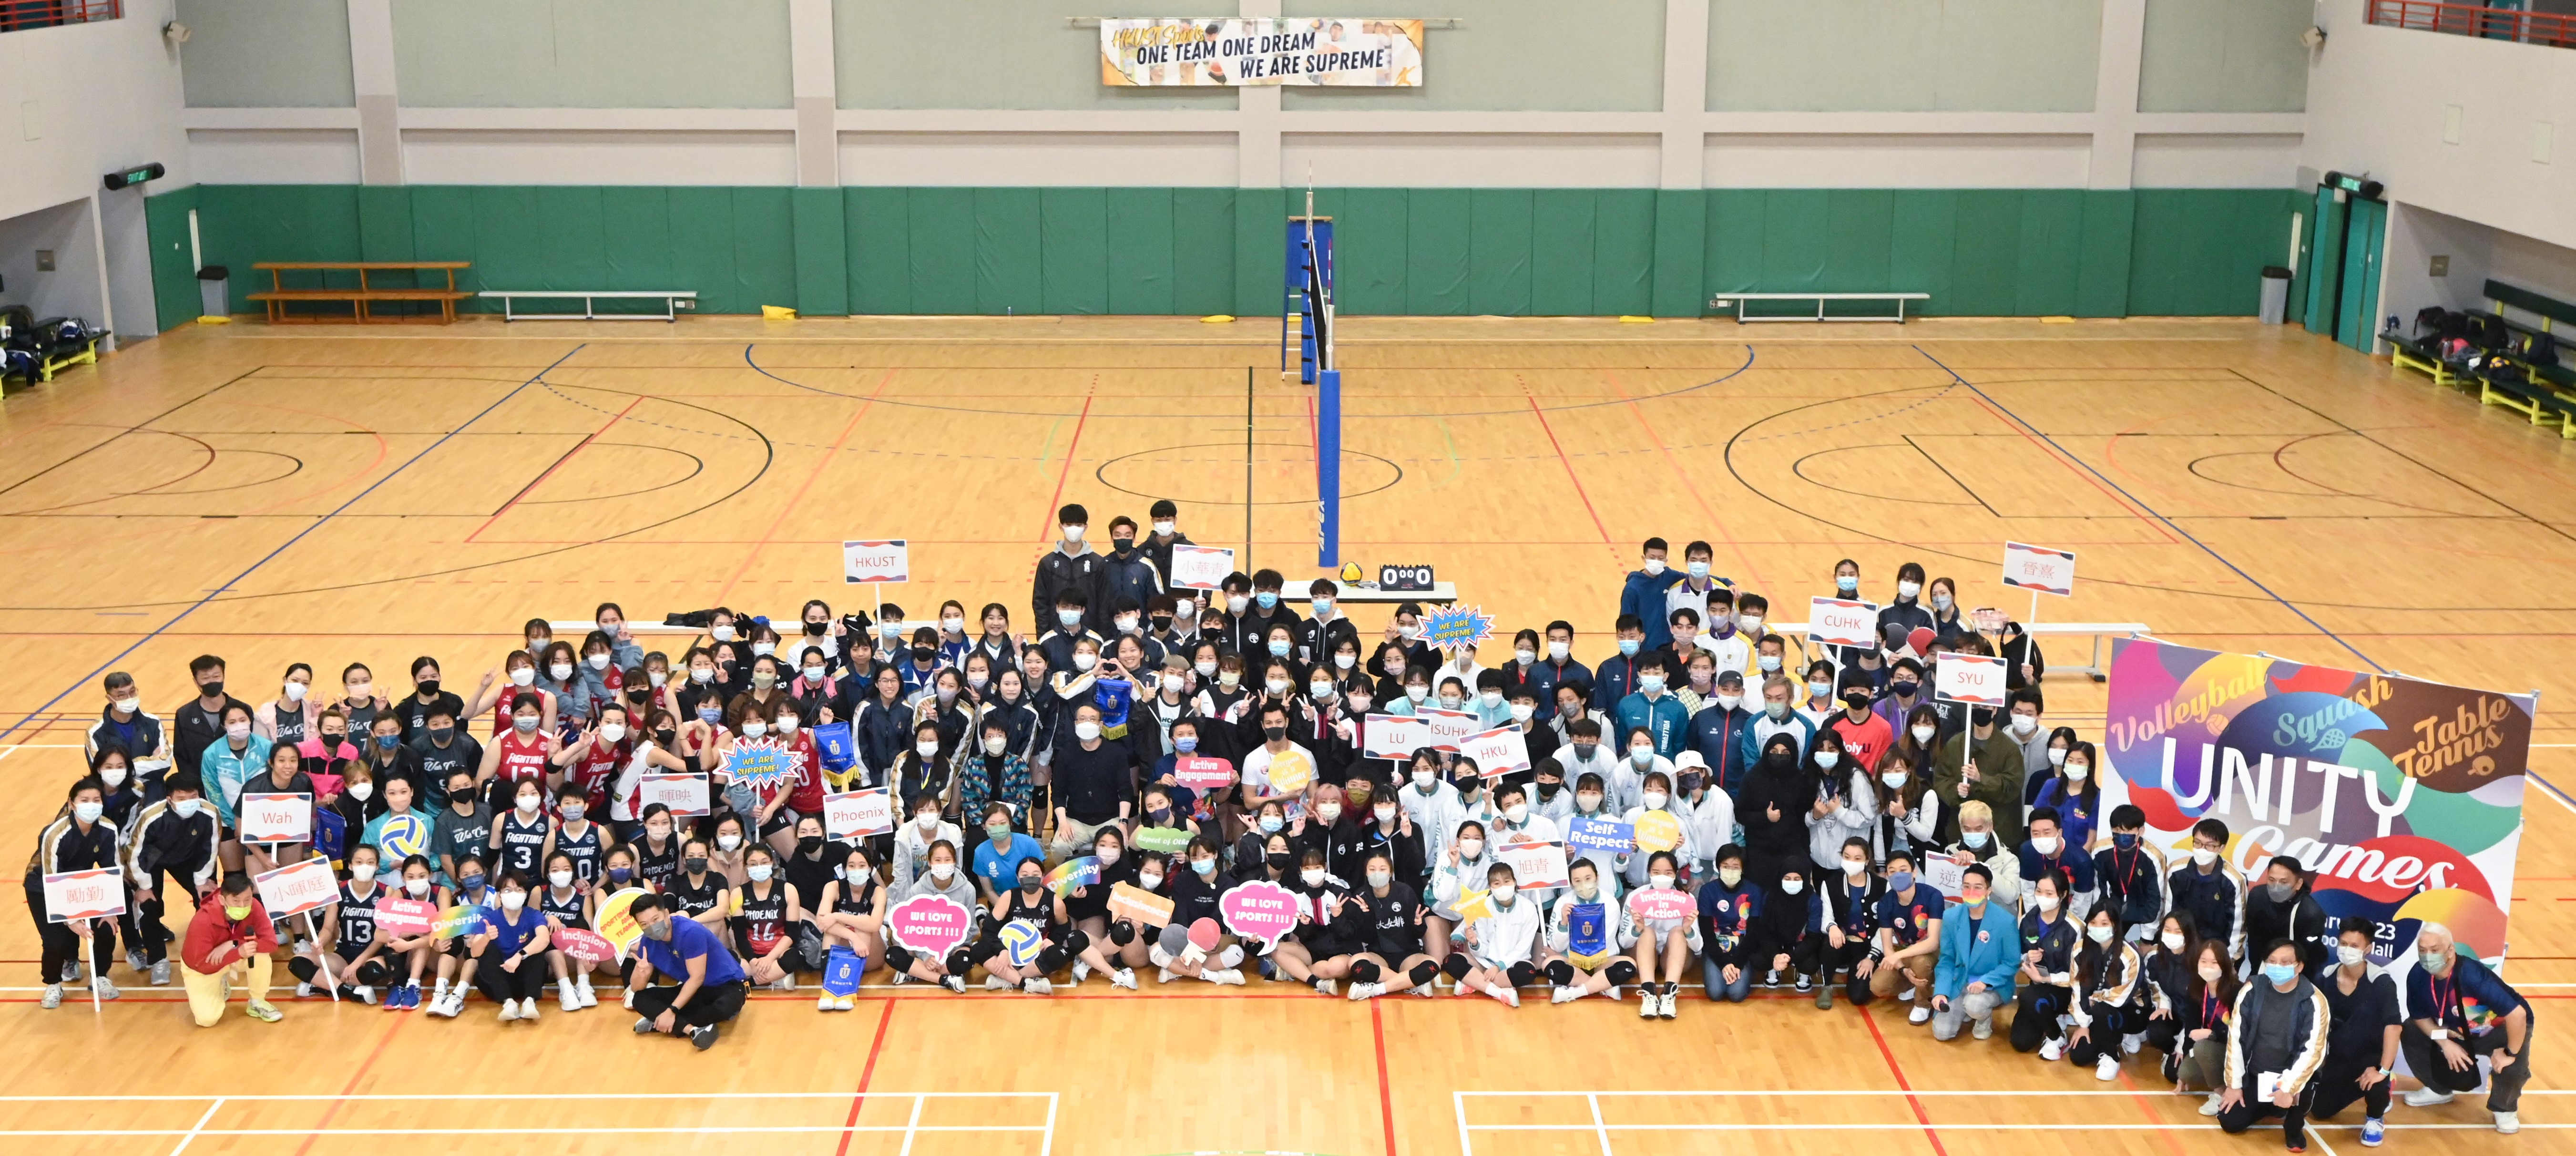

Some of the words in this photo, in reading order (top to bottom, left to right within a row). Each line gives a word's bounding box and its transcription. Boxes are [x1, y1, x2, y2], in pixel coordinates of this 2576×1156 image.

[1112, 26, 1163, 50] HKUST
[1163, 24, 1205, 50] Sports
[1137, 45, 1169, 65] ONE
[1176, 41, 1216, 61] TEAM
[1223, 37, 1255, 57] ONE
[1260, 31, 1316, 53] DREAM
[1240, 59, 1264, 78] WE
[1269, 55, 1300, 76] ARE
[1306, 49, 1384, 73] SUPREME
[856, 556, 896, 568] HKUST
[1183, 560, 1224, 577] 小華青
[1383, 568, 1397, 585] 0
[1416, 568, 1431, 585] 0
[1439, 622, 1452, 631] WE
[1454, 619, 1470, 628] ARE
[1825, 615, 1862, 630] CUHK
[1434, 627, 1475, 640] SUPREME!
[1958, 672, 1983, 685] SYU
[2111, 658, 2268, 752] Volleyball
[2273, 674, 2393, 747] Squash
[2413, 695, 2511, 755] Table
[1390, 733, 1405, 744] LU
[1661, 720, 1670, 753] VOLLEYBALL
[1480, 744, 1507, 760] HKU
[1843, 741, 1871, 755] olyU
[2392, 724, 2504, 778] Tennis
[506, 753, 544, 765] FIGHTING
[742, 757, 755, 766] WE
[758, 755, 775, 764] ARE
[1189, 760, 1218, 770] Active
[587, 761, 614, 773] FIGHTIN
[736, 764, 779, 776] SUPREME!
[1176, 769, 1231, 782] Engagement
[2160, 737, 2418, 838] UNITY
[659, 788, 692, 803] 暉映
[263, 811, 292, 824] Wah
[833, 807, 885, 823] Phoenix
[1585, 821, 1618, 835] Self-
[505, 832, 544, 844] FIGHTING
[1571, 830, 1631, 849] Respect
[514, 846, 532, 869] 3
[2232, 825, 2458, 893] Games
[1517, 858, 1549, 874] 旭青
[1046, 864, 1099, 892] Diversity
[1939, 868, 1962, 889] 逆
[274, 876, 326, 902] 小暉庭
[1241, 898, 1256, 907] WE
[1259, 899, 1283, 910] LOVE
[1640, 890, 1687, 904] Inclusion
[1658, 900, 1669, 909] in
[341, 906, 374, 917] FIGHTIN
[390, 900, 423, 914] Active
[1112, 891, 1170, 919] Inclusiveness
[1645, 906, 1681, 918] Action
[431, 914, 482, 932] Diversit
[910, 912, 926, 921] WE
[928, 913, 953, 922] LOVE
[1235, 911, 1273, 922] SPORTS
[1276, 914, 1289, 924] !!!
[347, 919, 372, 943] 13
[752, 922, 775, 941] 16
[904, 925, 942, 936] SPORTS
[945, 927, 959, 937] !!!
[2374, 922, 2396, 941] 23
[562, 930, 607, 949] Inclusion
[579, 941, 589, 951] in
[564, 945, 600, 961] Action
